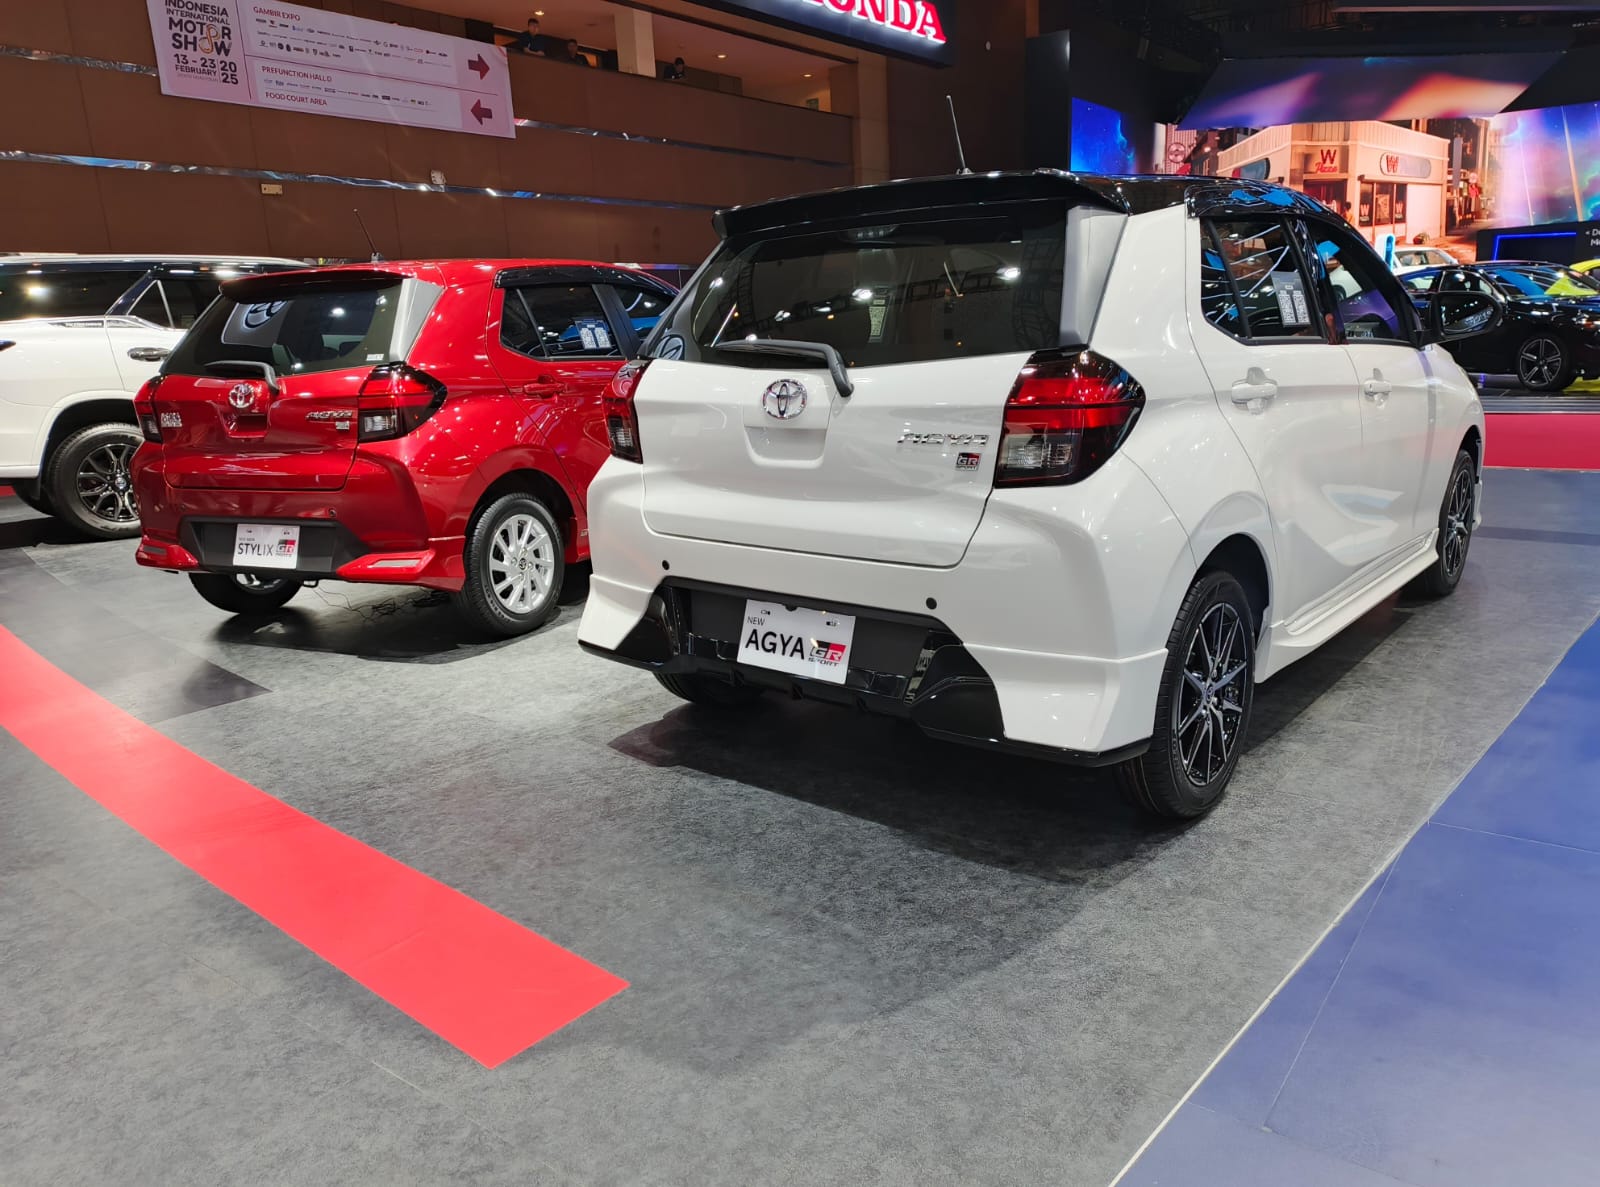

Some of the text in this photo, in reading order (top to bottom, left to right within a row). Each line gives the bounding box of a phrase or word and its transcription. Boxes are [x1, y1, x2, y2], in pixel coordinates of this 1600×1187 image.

[164, 0, 229, 17] INDONESIA
[253, 6, 301, 21] GAMBIR EXPO
[166, 8, 231, 26] INTERNATIONAL
[173, 53, 189, 65] 13
[199, 57, 217, 69] 23
[219, 60, 237, 73] 20
[175, 64, 218, 77] FEBRUARY
[261, 66, 309, 79] PREFUNCTION
[221, 72, 239, 85] 25
[265, 91, 328, 106] FOOD COURT AREA
[1320, 149, 1337, 164] W
[957, 454, 979, 466] GR
[237, 542, 274, 557] STYLIX
[747, 616, 765, 626] NEW
[745, 628, 846, 662] AGYA GR
[808, 657, 839, 667] SPORT
